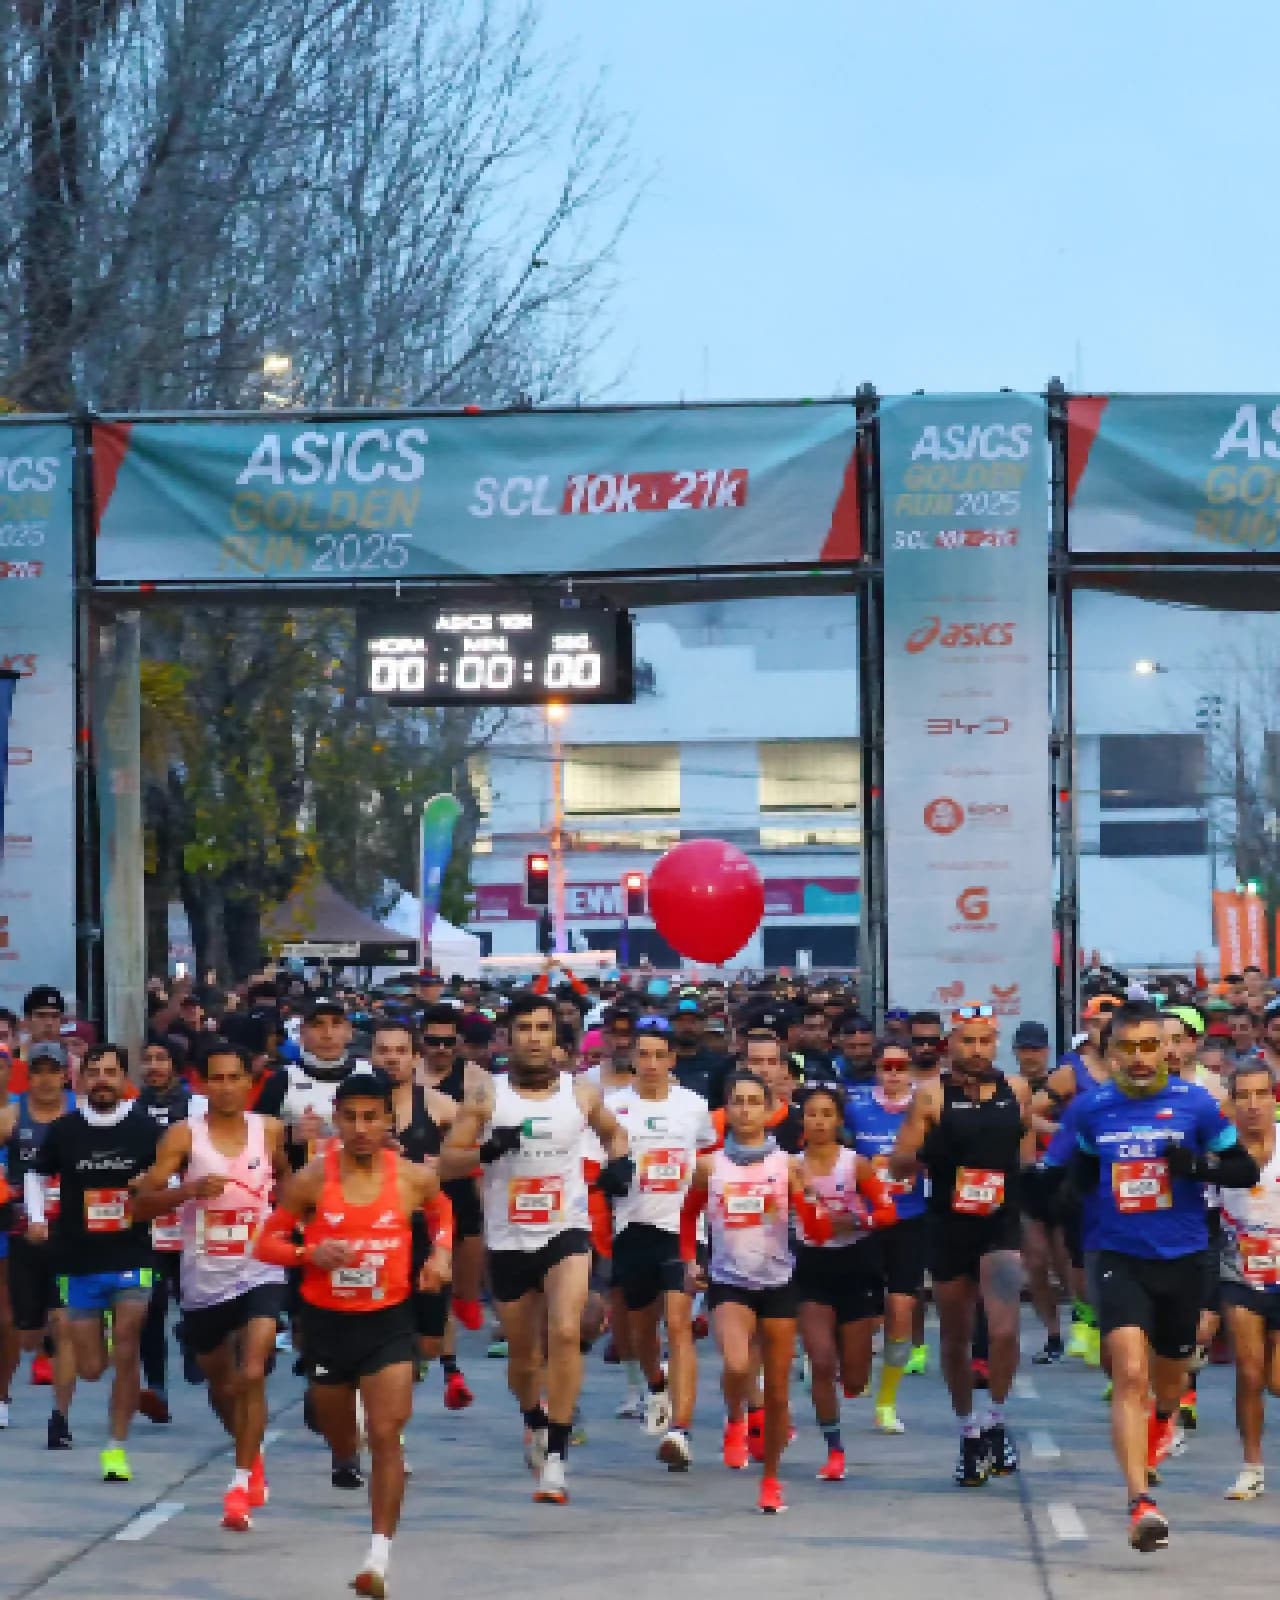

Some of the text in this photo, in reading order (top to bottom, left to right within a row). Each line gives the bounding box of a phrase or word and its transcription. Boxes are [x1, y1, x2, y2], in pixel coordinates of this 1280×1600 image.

[236, 428, 428, 485] ASICS
[910, 424, 1032, 460] ASICS
[230, 488, 424, 530] GOLDEN
[467, 474, 557, 516] SCL
[956, 490, 1021, 516] 2025
[312, 534, 413, 571] 2025
